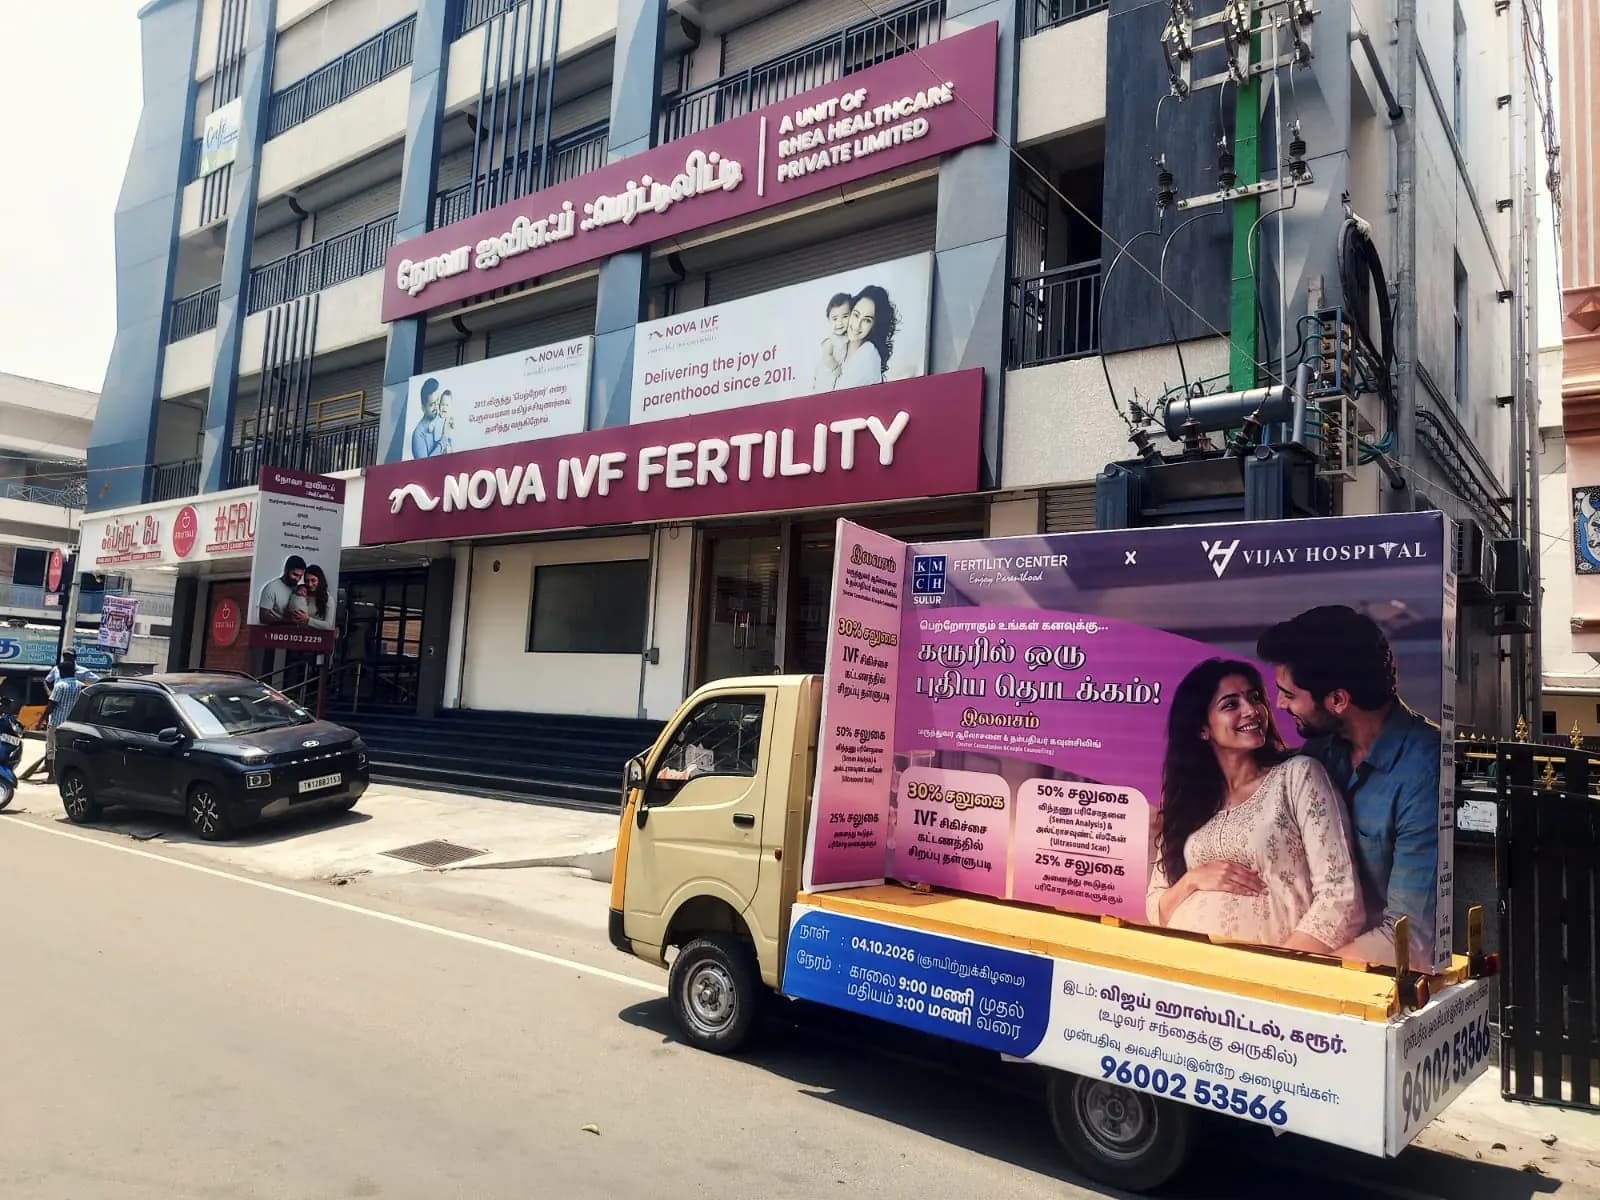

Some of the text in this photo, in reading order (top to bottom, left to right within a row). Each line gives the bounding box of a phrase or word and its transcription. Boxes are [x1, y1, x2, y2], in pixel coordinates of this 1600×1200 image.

[778, 81, 954, 158] RHEA HEALTHCARE
[779, 88, 867, 134] A UNIT OF
[777, 117, 929, 182] PRIVATE LIMITED
[397, 246, 472, 297] நோவா
[666, 321, 697, 337] NOVA
[700, 315, 719, 329] IVF
[538, 347, 564, 362] NOVA
[567, 343, 583, 356] IVF
[644, 345, 777, 386] Delivering the joy of
[643, 366, 796, 411] parenthood since 2011.
[442, 410, 911, 513] NOVA IVF FERTILITY
[851, 544, 897, 573] இலவசம்
[954, 554, 1068, 571] FERTILITY CENTER
[1242, 548, 1299, 568] VIJAY
[1306, 542, 1427, 562] HOSPITAL
[969, 570, 1043, 587] Enjoy Parenthood
[913, 595, 942, 605] SULUR
[270, 633, 289, 642] 1800
[838, 618, 898, 647] 30% சலுகை
[920, 619, 996, 634] பெற்றோராகும்
[999, 620, 1039, 631] உங்கள்
[842, 646, 860, 663] IVF
[917, 636, 1086, 670] கரூரில் ஒரு
[916, 670, 986, 703] புதிய
[960, 707, 1040, 729] இலவசம்
[835, 726, 886, 743] 50% சலுகை
[908, 782, 1005, 810] 30% சலுகை
[1037, 785, 1129, 806] 50% சலுகை
[829, 813, 879, 828] 25% சலுகை
[914, 809, 987, 834] IVF சிகிச்சை
[1049, 815, 1113, 831] (Semen Analysis) &
[908, 845, 992, 872] சிறப்பு தள்ளுபடி
[1050, 838, 1110, 854] (Ultrasound Scan)
[1035, 853, 1125, 876] 25% சலுகை
[799, 922, 830, 941] நாள்
[851, 936, 915, 962] 04.10.2026
[916, 953, 1026, 988] (ஞாயிற்றுக்கிழமை)
[796, 949, 832, 971] நேரம்
[849, 965, 896, 987] காலை
[899, 976, 927, 995] 9:00
[930, 986, 975, 1007] மணி
[979, 996, 1025, 1020] முதல்
[847, 982, 1021, 1040] மதியம் 3:00 மணி வரை
[1062, 979, 1348, 1055] இடம்: விஜய் ஹாஸ்பிட்டல், கரூர்.
[1063, 1025, 1121, 1051] முன்பதிவு
[1098, 1007, 1298, 1067] (உழவர் சந்தைக்கு அருகில்)
[1402, 1009, 1491, 1134] 96002 53566
[1100, 1055, 1289, 1126] 96002 53566
